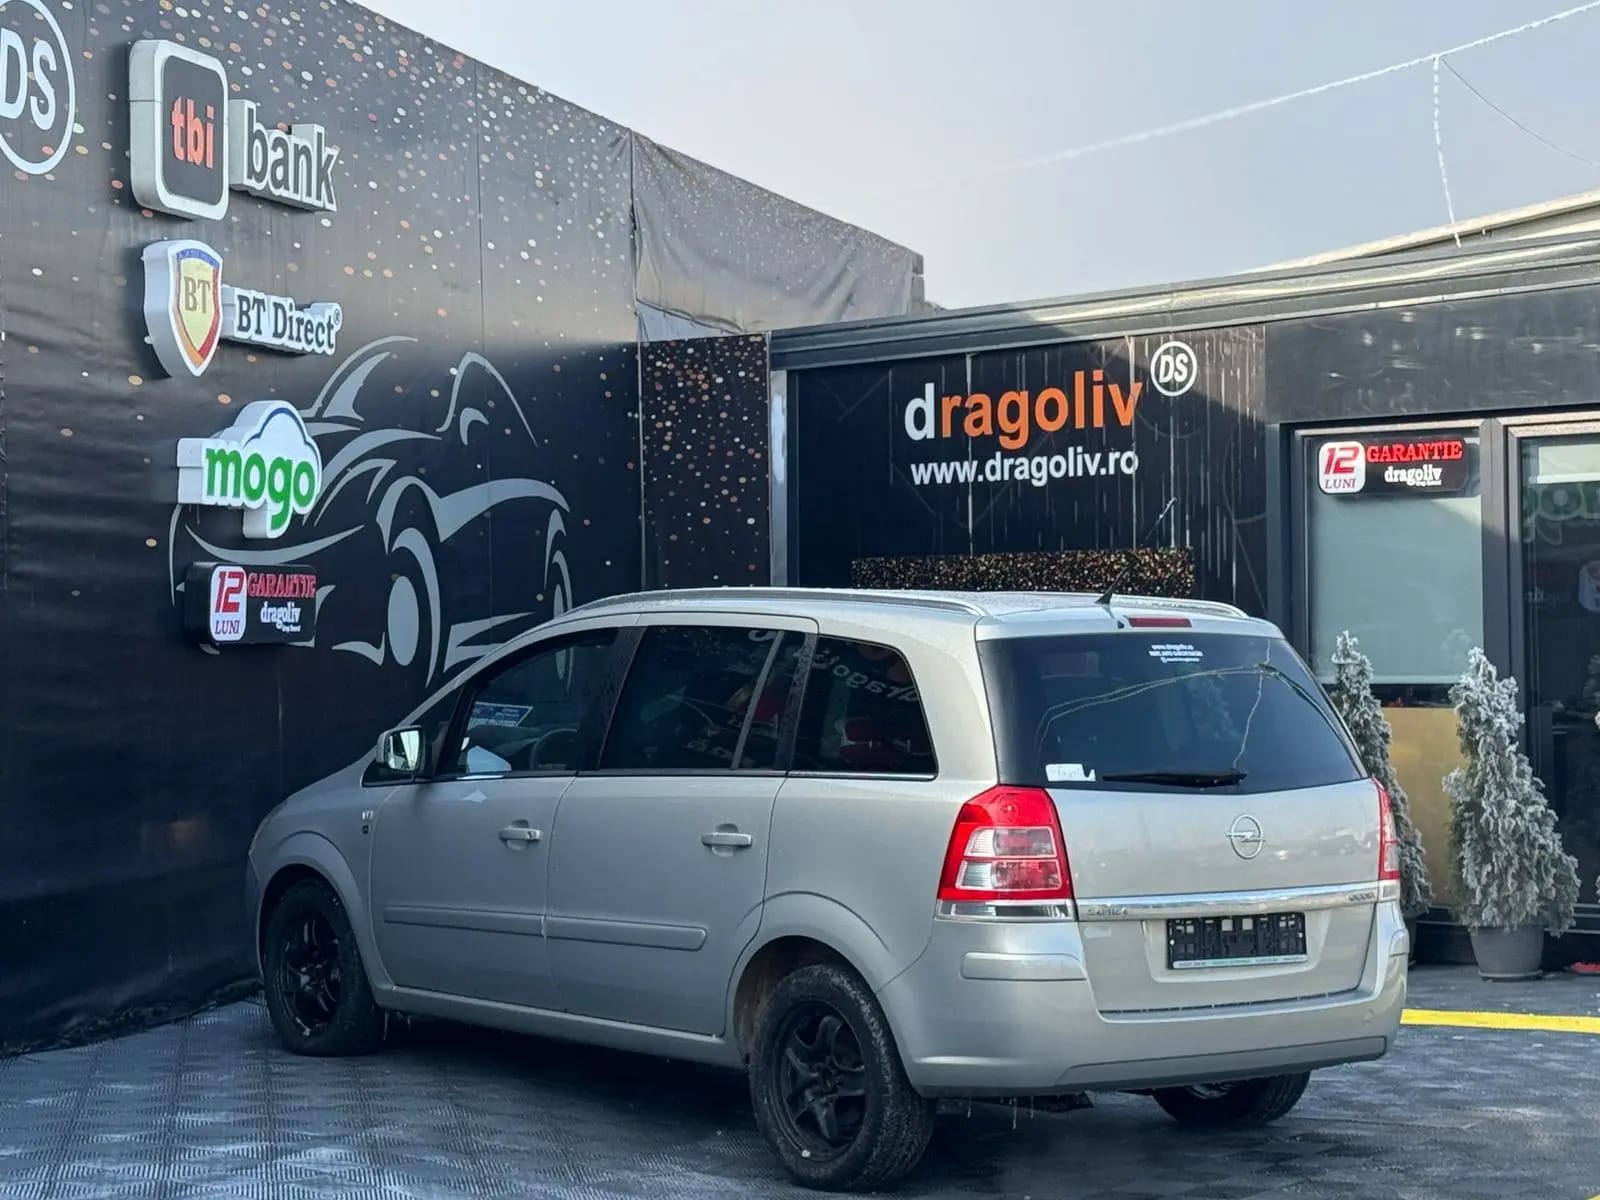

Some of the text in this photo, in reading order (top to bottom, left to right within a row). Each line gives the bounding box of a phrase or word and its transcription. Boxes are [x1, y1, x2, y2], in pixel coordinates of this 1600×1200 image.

[0, 27, 57, 131] DS
[171, 96, 216, 169] tbi
[246, 107, 336, 203] bank
[183, 276, 211, 314] BT
[237, 294, 266, 335] BT
[1158, 353, 1189, 384] DS
[904, 369, 1143, 449] dragoliv
[910, 446, 1139, 487] www.dragoliv.ro
[1324, 440, 1463, 475] 12 GARANTIE
[1384, 464, 1442, 486] dragoliv
[206, 448, 315, 530] mogo
[1324, 479, 1356, 489] LUNI
[215, 571, 317, 613] 12 GARANTIE
[214, 620, 241, 635] LUNI
[260, 601, 301, 629] dragoliv
